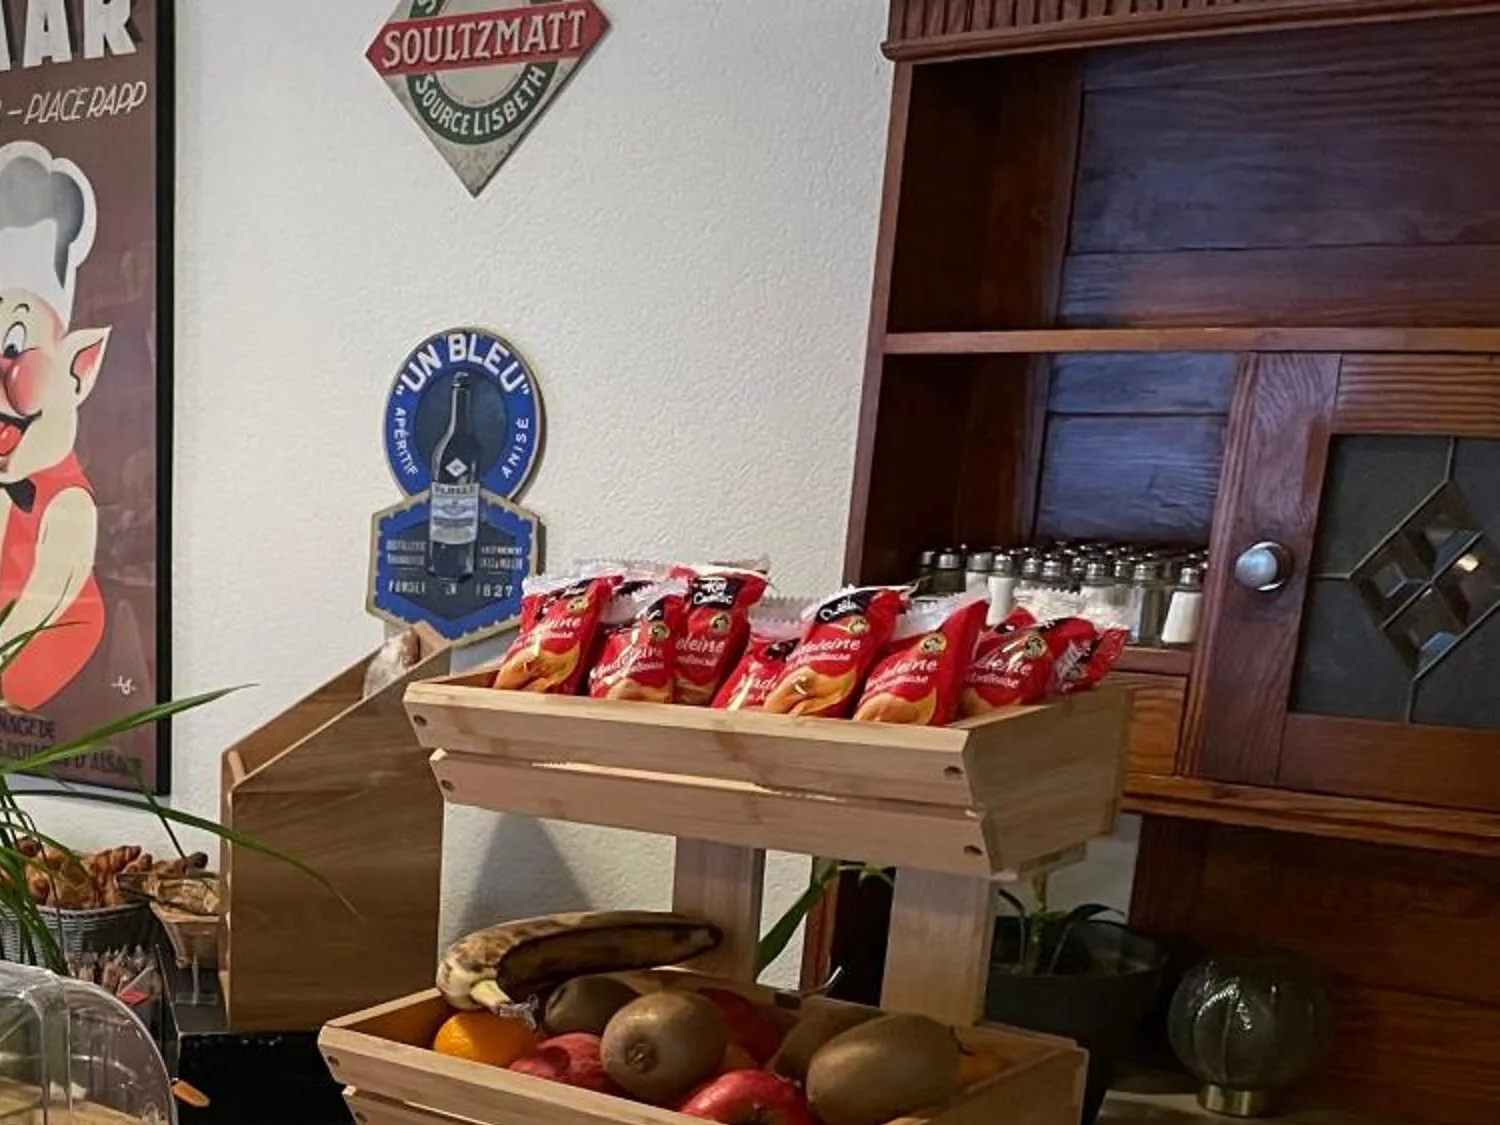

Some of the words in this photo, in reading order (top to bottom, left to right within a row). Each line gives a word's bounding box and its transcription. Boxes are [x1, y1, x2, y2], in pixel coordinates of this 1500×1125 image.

[381, 9, 587, 69] SOULTZMATT
[23, 90, 85, 125] PLACE
[86, 81, 149, 118] RAPP
[415, 73, 471, 136] SOURCE
[473, 65, 548, 137] LISBETH
[393, 407, 419, 477] APÉRITIF
[501, 417, 529, 479] ANISÉ
